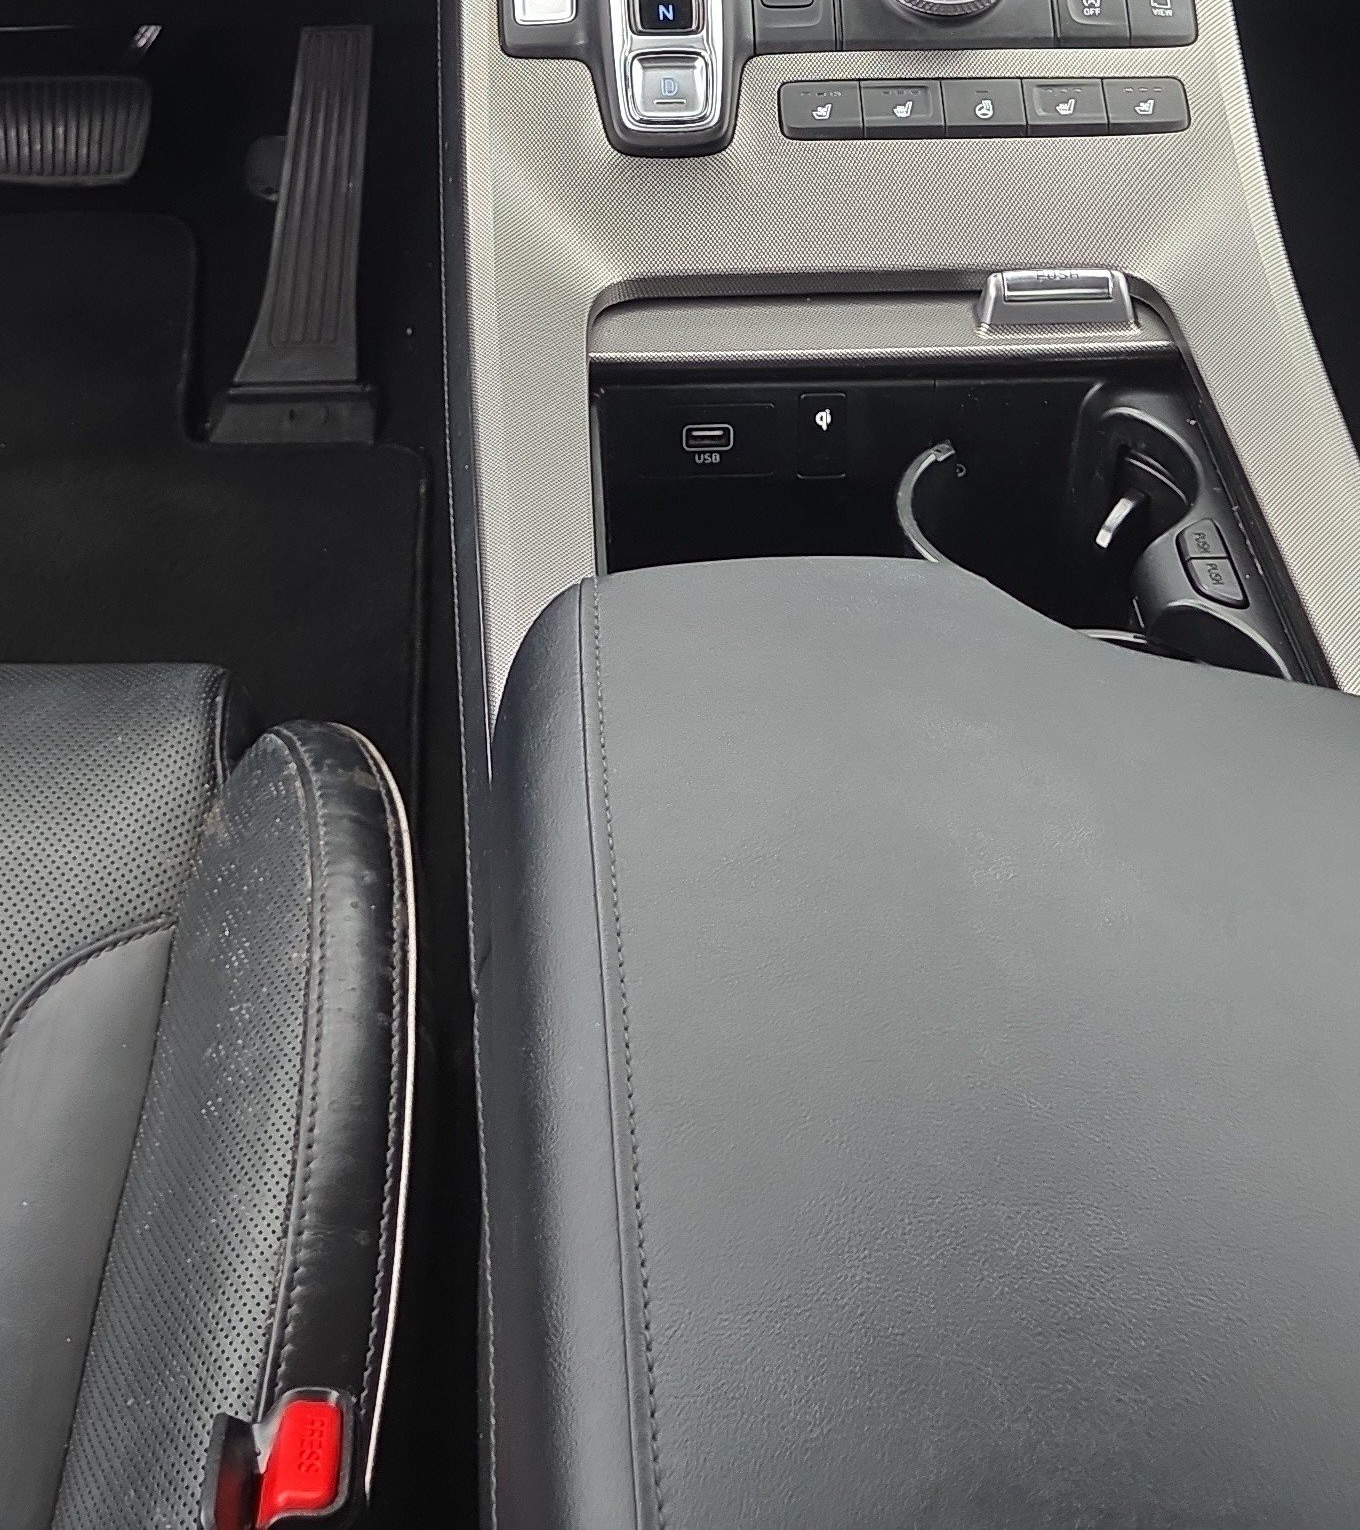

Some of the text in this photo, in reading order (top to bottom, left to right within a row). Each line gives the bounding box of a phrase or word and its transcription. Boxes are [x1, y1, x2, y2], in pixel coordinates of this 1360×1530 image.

[658, 4, 674, 21] N
[1083, 7, 1101, 16] OFF
[1152, 8, 1173, 17] VIEW
[660, 77, 678, 96] D
[694, 453, 721, 464] USB
[1206, 563, 1225, 585] PUSH
[297, 1417, 326, 1474] PRESS
